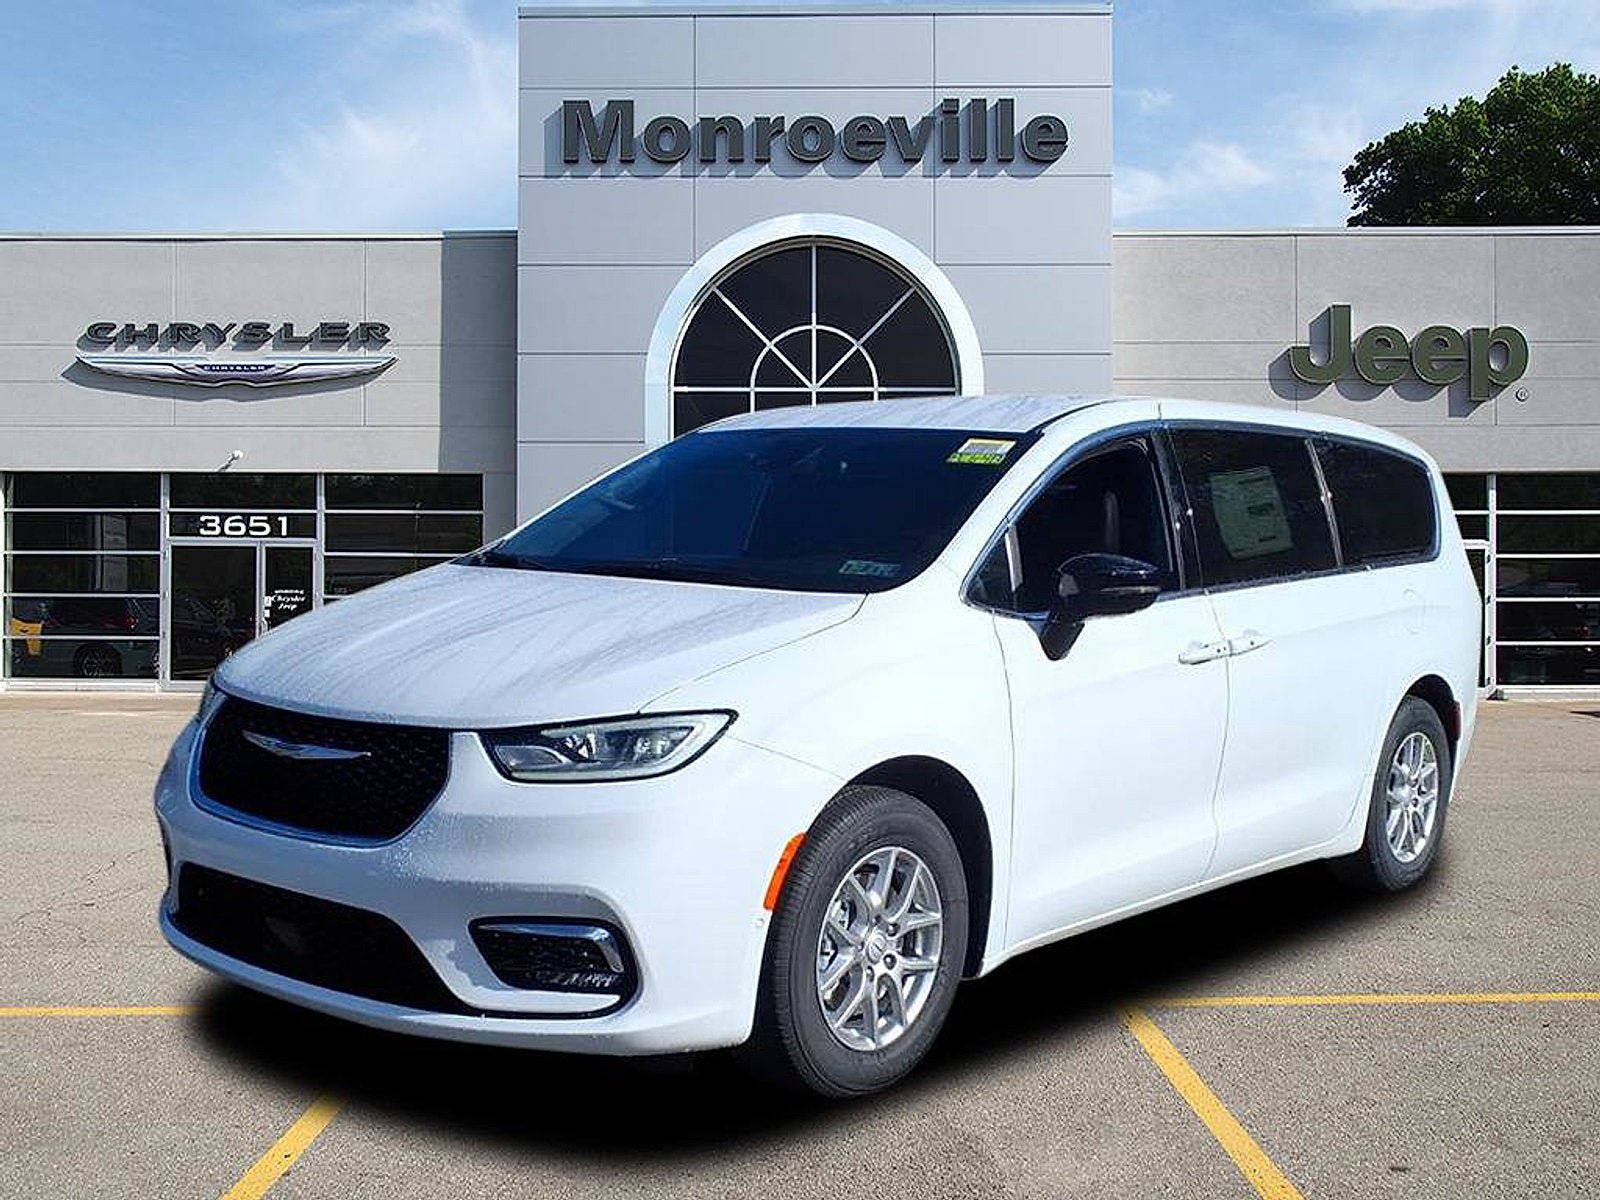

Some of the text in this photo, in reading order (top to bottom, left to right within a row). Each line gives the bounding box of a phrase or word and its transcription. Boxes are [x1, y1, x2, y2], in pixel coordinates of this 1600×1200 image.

[561, 98, 1068, 164] Monroeville
[86, 321, 391, 345] CHRYSLER
[1289, 303, 1529, 401] Jeep
[199, 515, 288, 536] 3651
